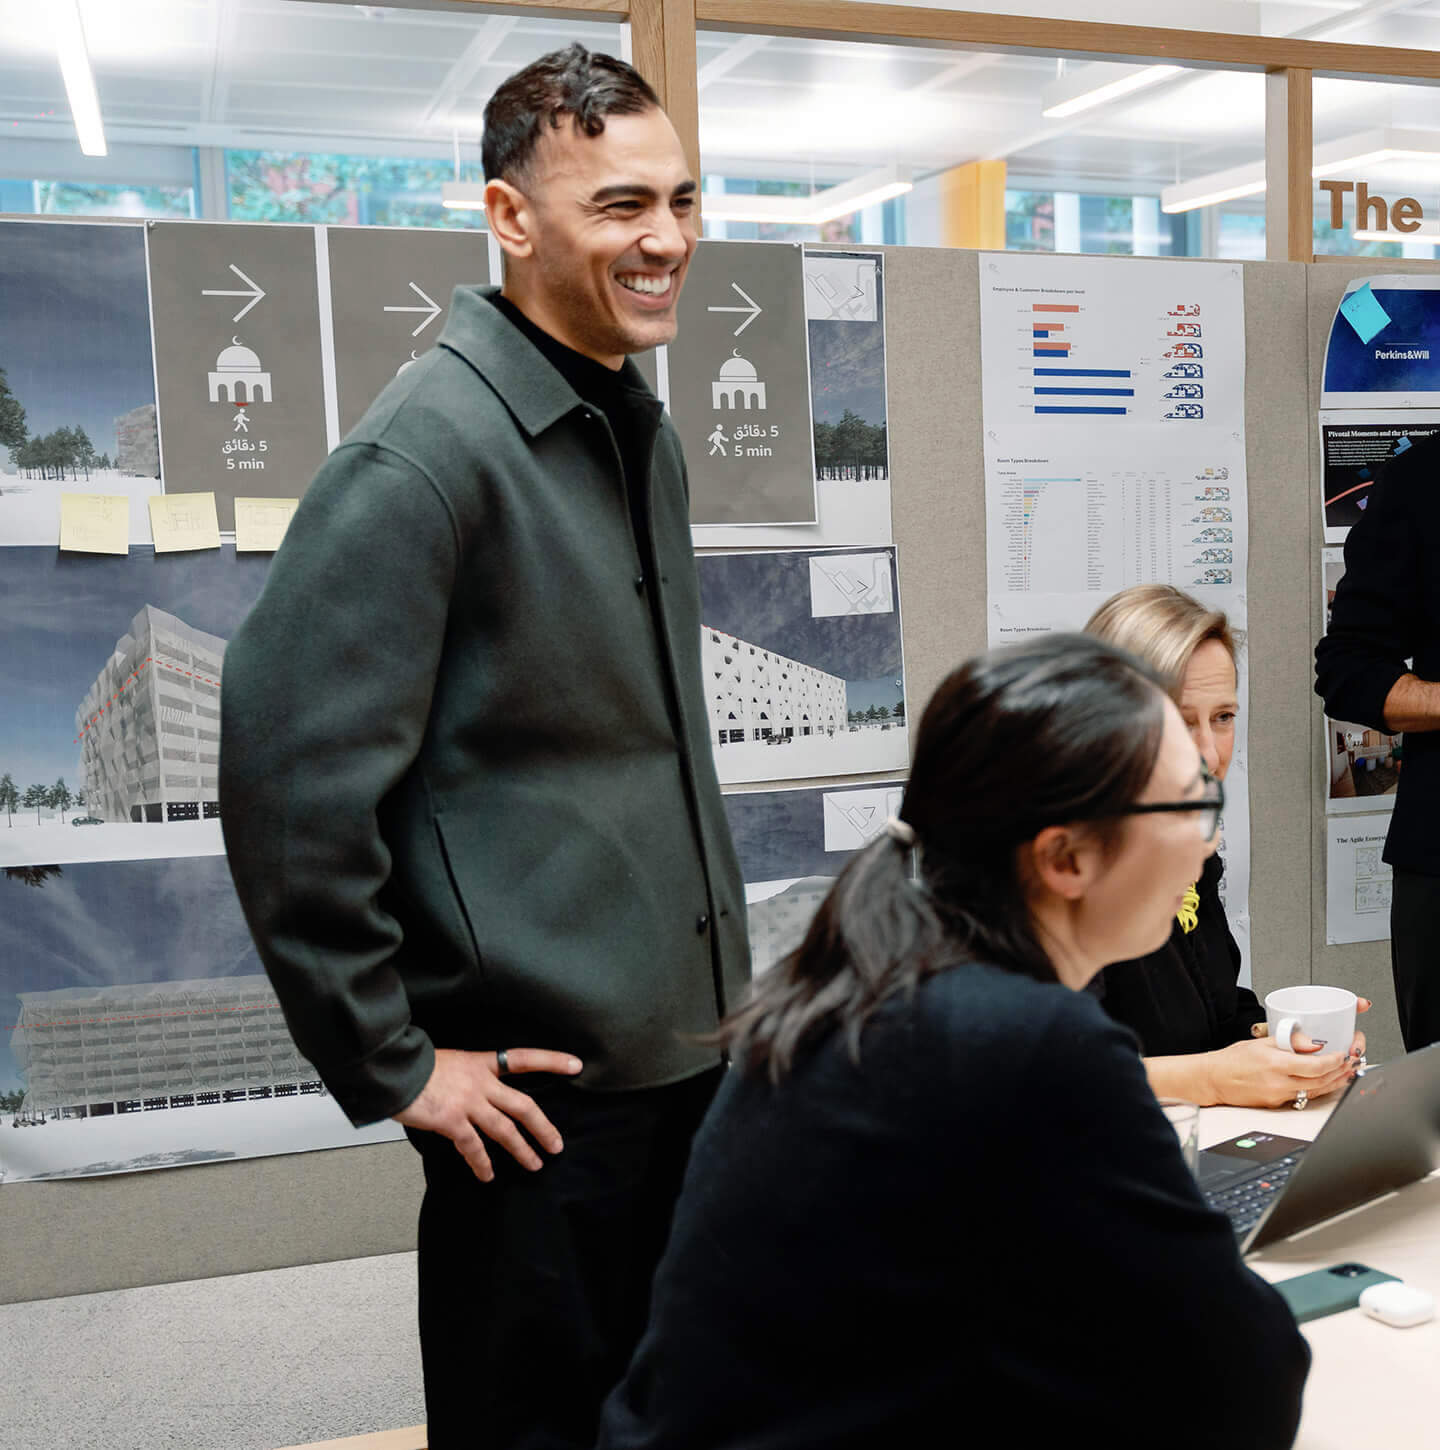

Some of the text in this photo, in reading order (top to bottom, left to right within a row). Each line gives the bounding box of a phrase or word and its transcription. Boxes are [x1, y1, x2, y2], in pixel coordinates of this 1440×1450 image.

[1319, 179, 1424, 234] The
[1374, 349, 1431, 360] Perkins&Will
[732, 424, 779, 441] 5 دقائق
[1350, 430, 1379, 438] Moments
[1379, 429, 1392, 437] and
[1391, 429, 1402, 437] the
[222, 438, 268, 454] 5 دقائق
[734, 444, 773, 457] 5 min
[226, 457, 265, 470] 5 min
